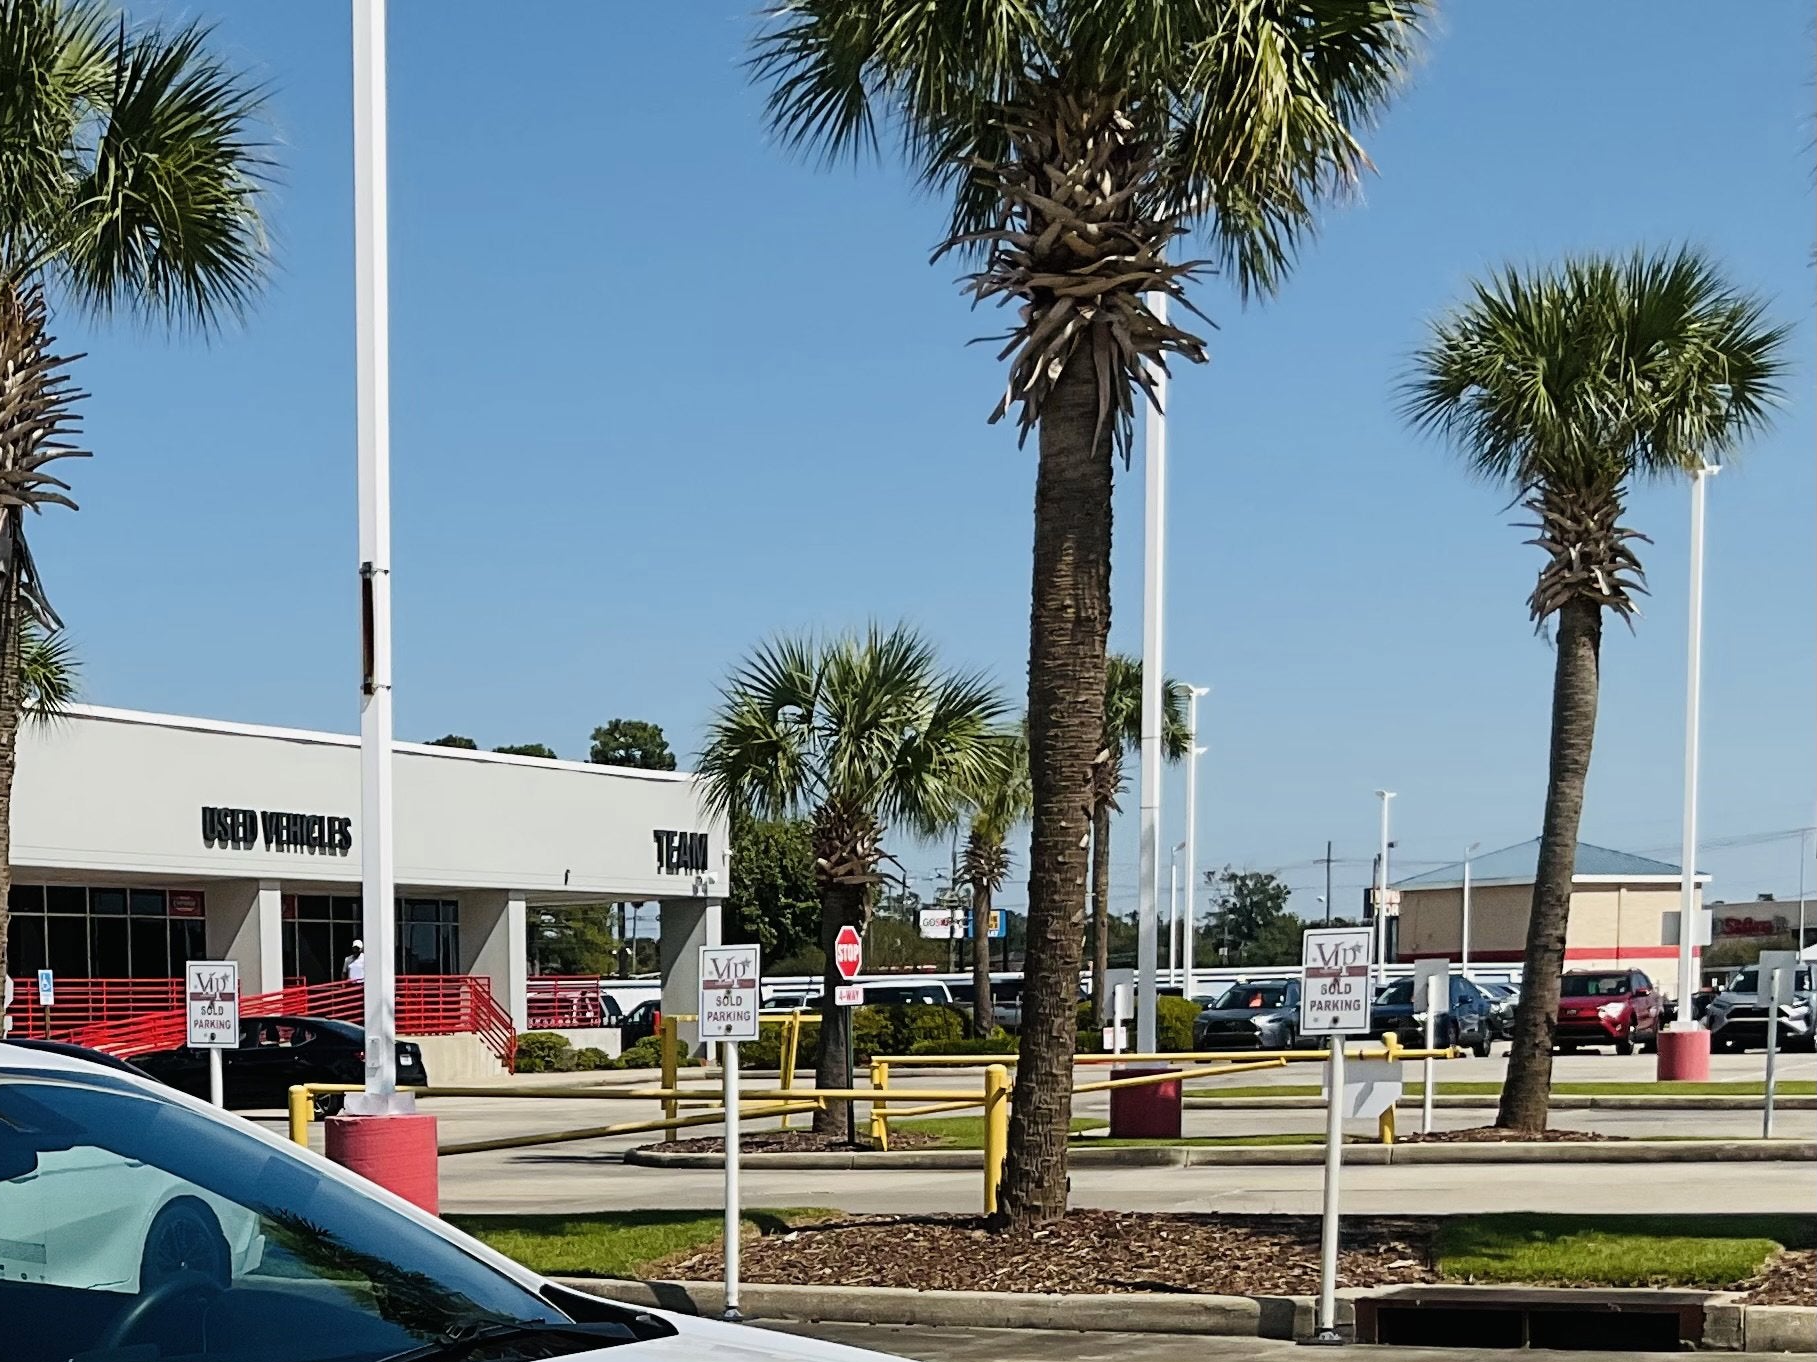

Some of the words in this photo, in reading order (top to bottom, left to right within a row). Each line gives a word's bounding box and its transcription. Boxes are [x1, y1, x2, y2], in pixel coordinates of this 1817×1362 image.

[201, 806, 258, 844] USED
[260, 811, 352, 852] VEHICLES
[653, 829, 708, 872] TEAM
[837, 943, 860, 963] STOP
[839, 989, 859, 1001] 4-WAY
[1320, 983, 1352, 996] SOLD
[716, 995, 743, 1007] SOLD
[1310, 999, 1361, 1012] PARKING
[200, 1005, 224, 1016] SOLD
[707, 1010, 751, 1022] PARKING
[193, 1019, 232, 1030] PARKING
